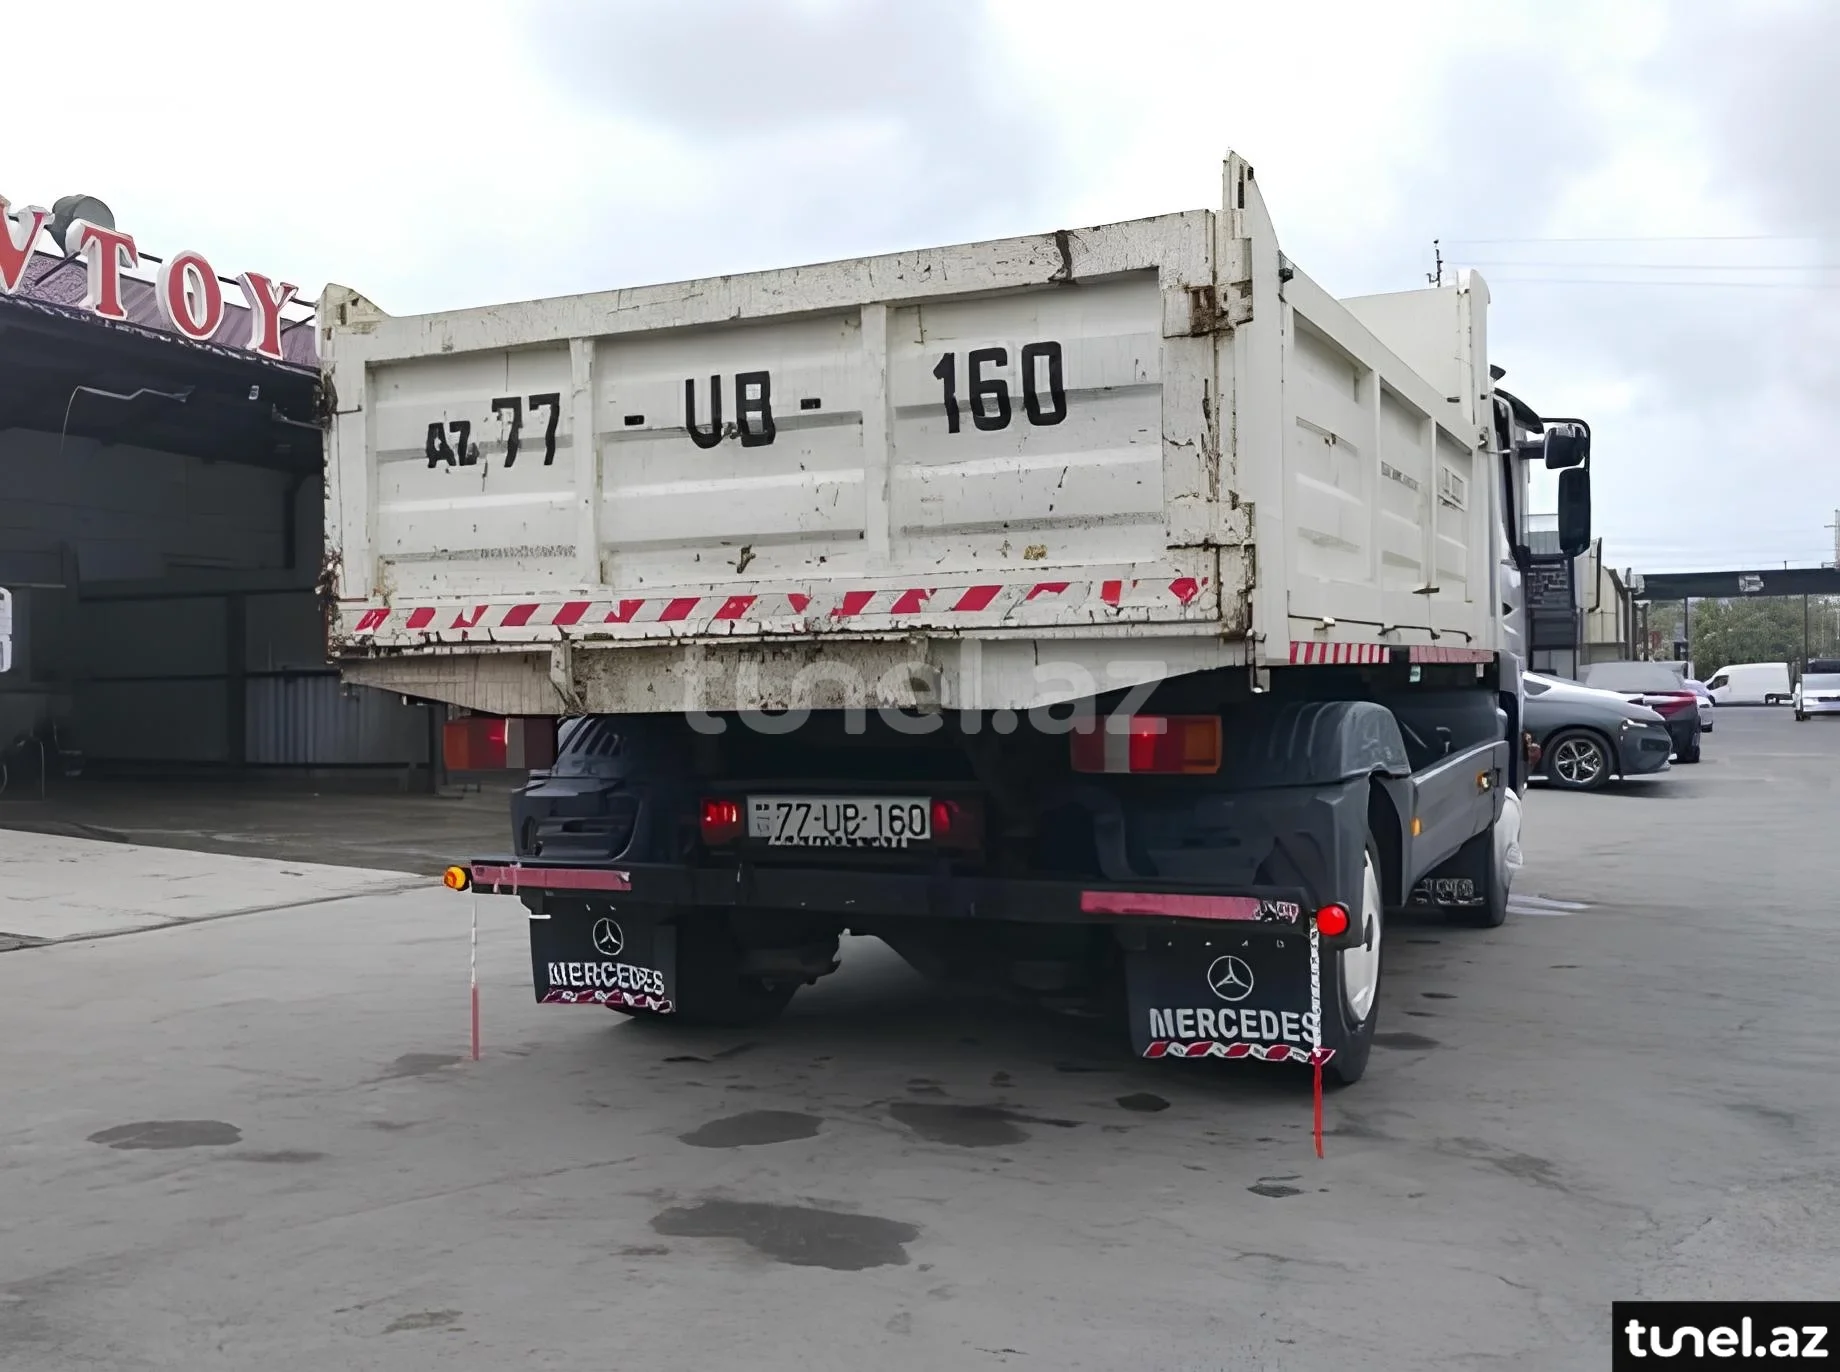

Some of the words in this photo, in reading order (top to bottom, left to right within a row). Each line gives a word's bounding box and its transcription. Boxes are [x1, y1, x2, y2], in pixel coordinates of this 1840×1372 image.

[425, 420, 479, 468] AZ
[491, 392, 560, 468] 77
[686, 370, 776, 449] UB
[933, 340, 1068, 434] 160
[547, 961, 666, 996] MERCEDES
